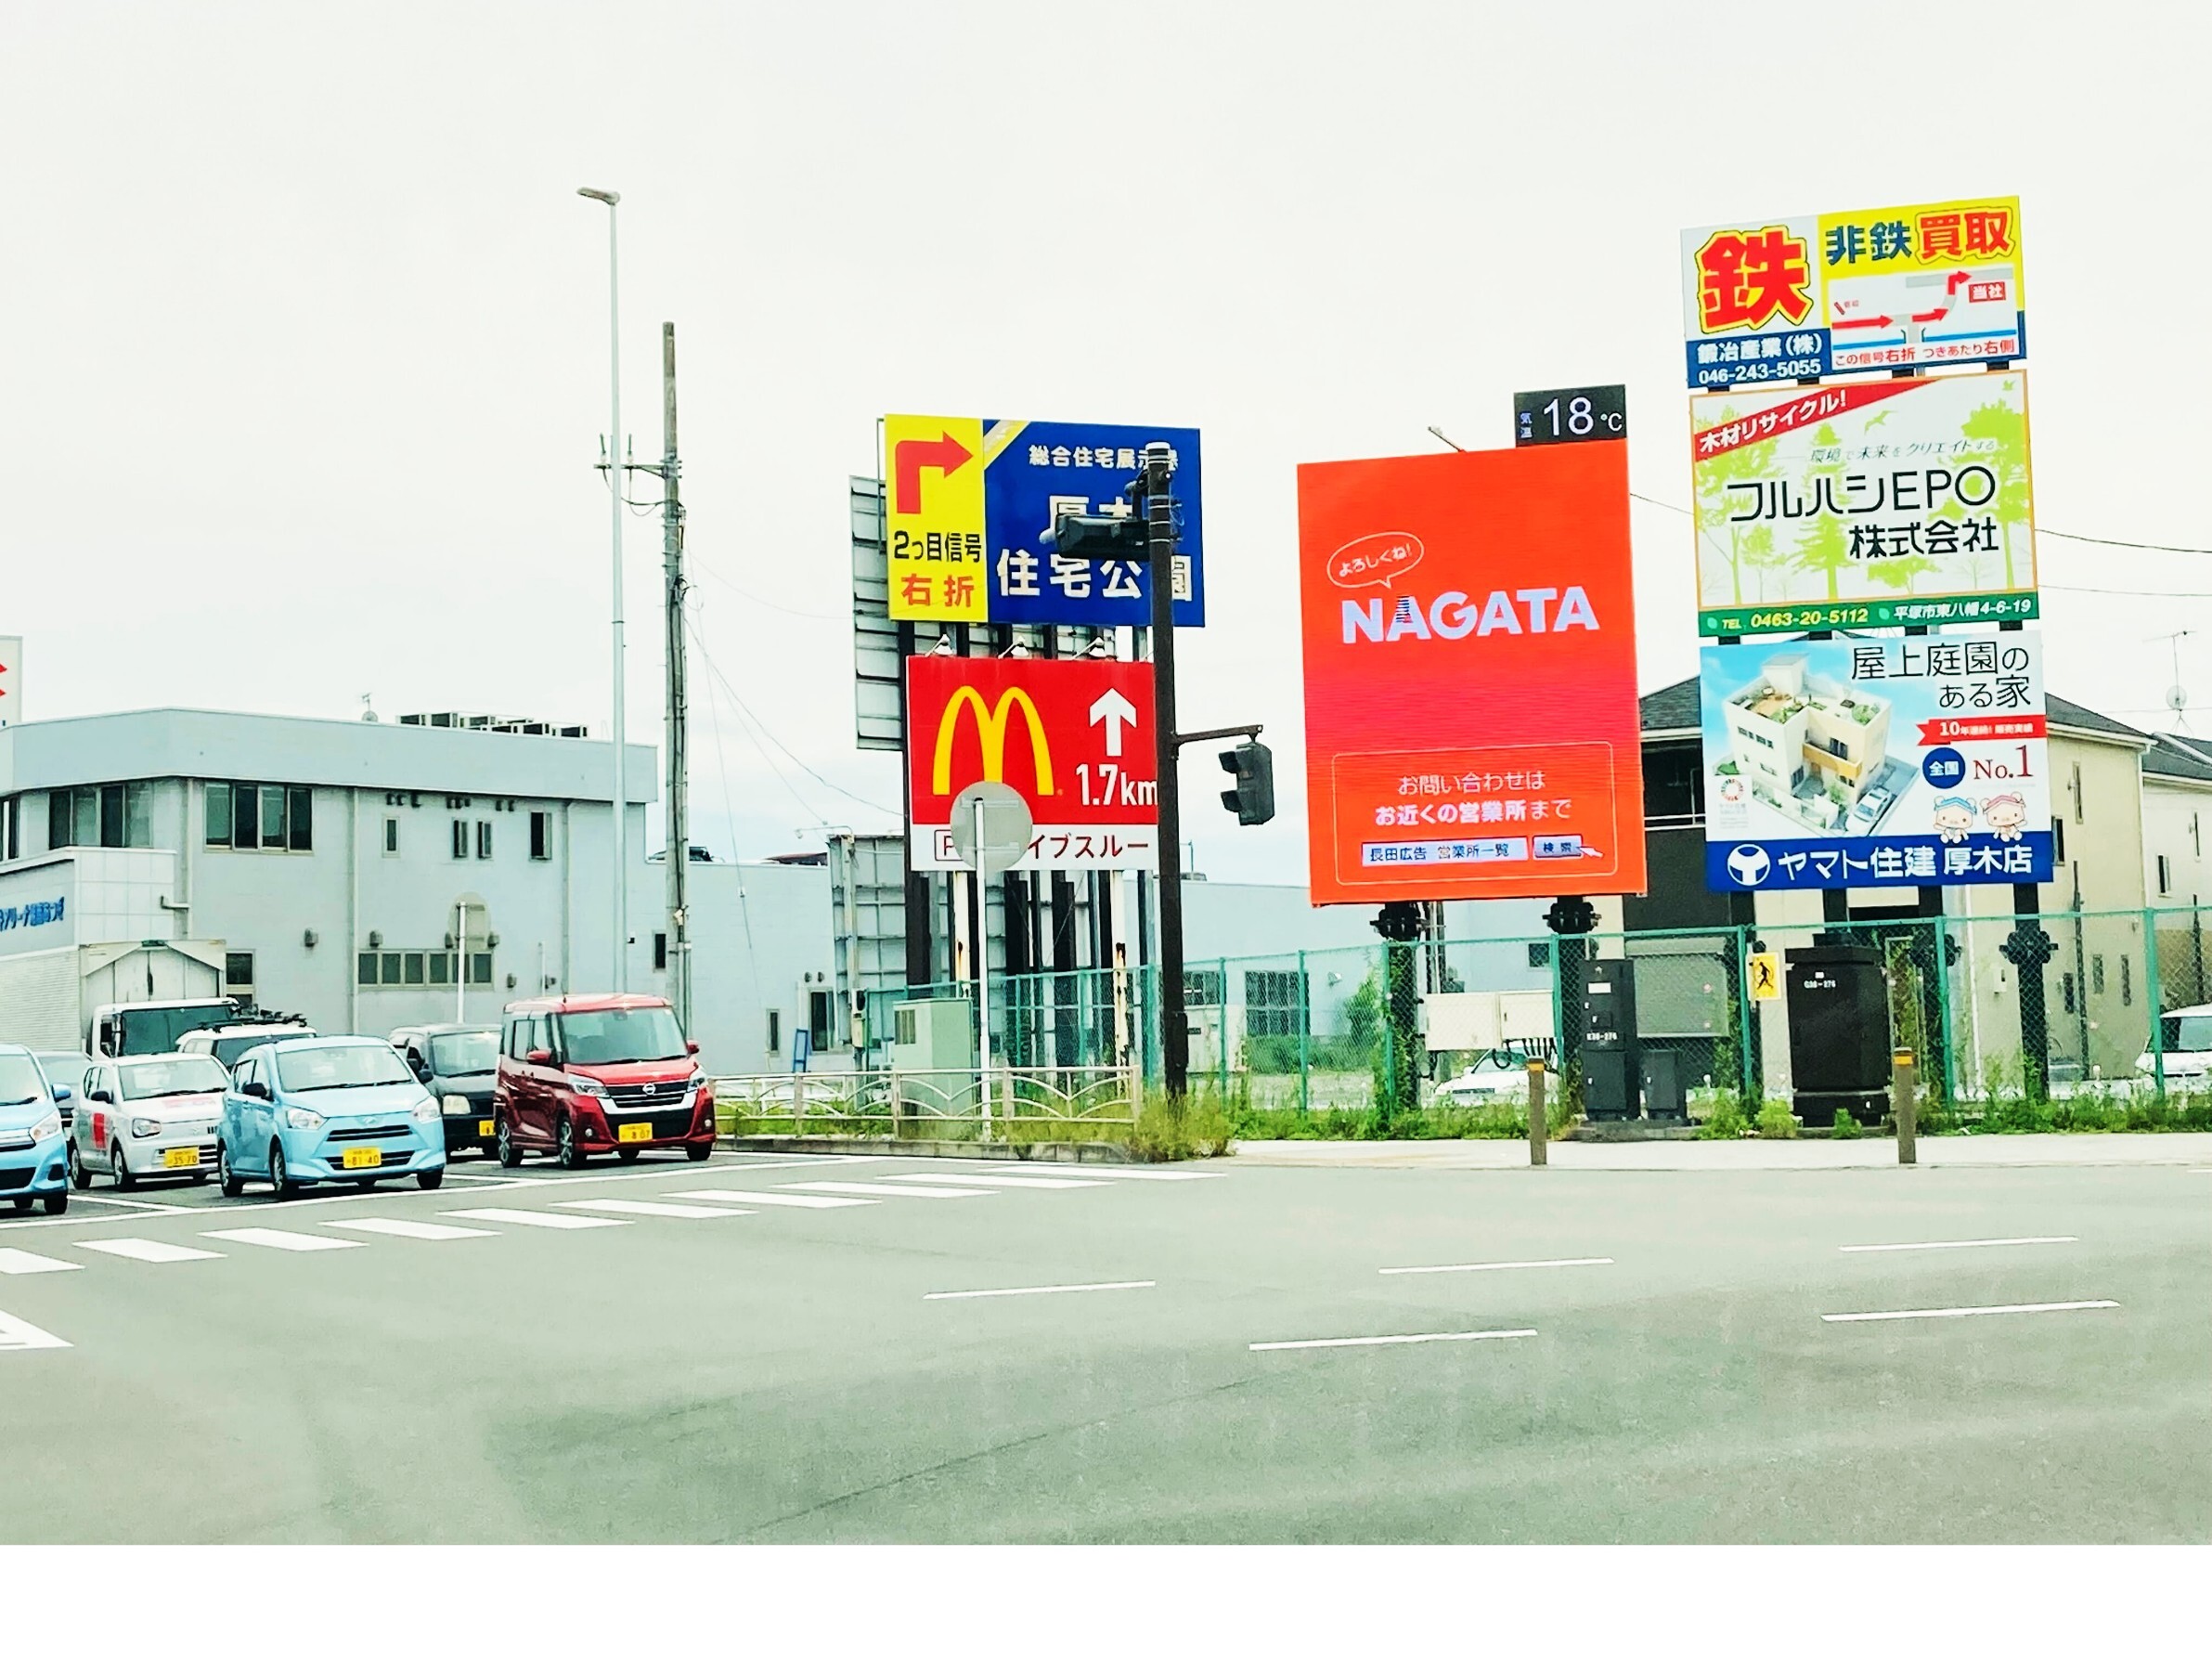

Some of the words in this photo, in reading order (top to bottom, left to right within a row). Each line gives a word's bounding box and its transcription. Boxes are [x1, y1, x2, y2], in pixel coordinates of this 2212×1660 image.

[1826, 211, 2011, 266] 非鉄買取
[1698, 228, 1813, 331] 鉄
[1973, 284, 2004, 300] 当社
[1835, 348, 1916, 366] この信号右折
[1922, 339, 2016, 358] つきあたり右側
[1698, 357, 1822, 384] 046-243-5055
[1544, 396, 1595, 436] 18
[1700, 389, 1848, 454] 木材リサイクル!
[1727, 464, 1997, 522] フルハシEPO
[1848, 516, 2000, 559] 株式会社
[901, 573, 975, 608] 右折
[1341, 586, 1600, 644] NAGATA
[1751, 608, 1869, 629] 0463-20-5112
[1851, 641, 2030, 680] 屋上庭園の
[1938, 675, 2032, 708] ある家
[1929, 760, 1960, 776] 全国
[1973, 744, 2034, 780] No.1
[1397, 770, 1546, 796] お問い合わせは
[1374, 798, 1572, 826] お近くの営業所まで
[1028, 832, 1149, 859] イブスルー
[1369, 847, 1428, 862] 長田広告
[1437, 843, 1510, 861] 営業所一覧
[1777, 845, 1937, 881] ヤマト住建
[1943, 845, 2033, 875] 厚木店
